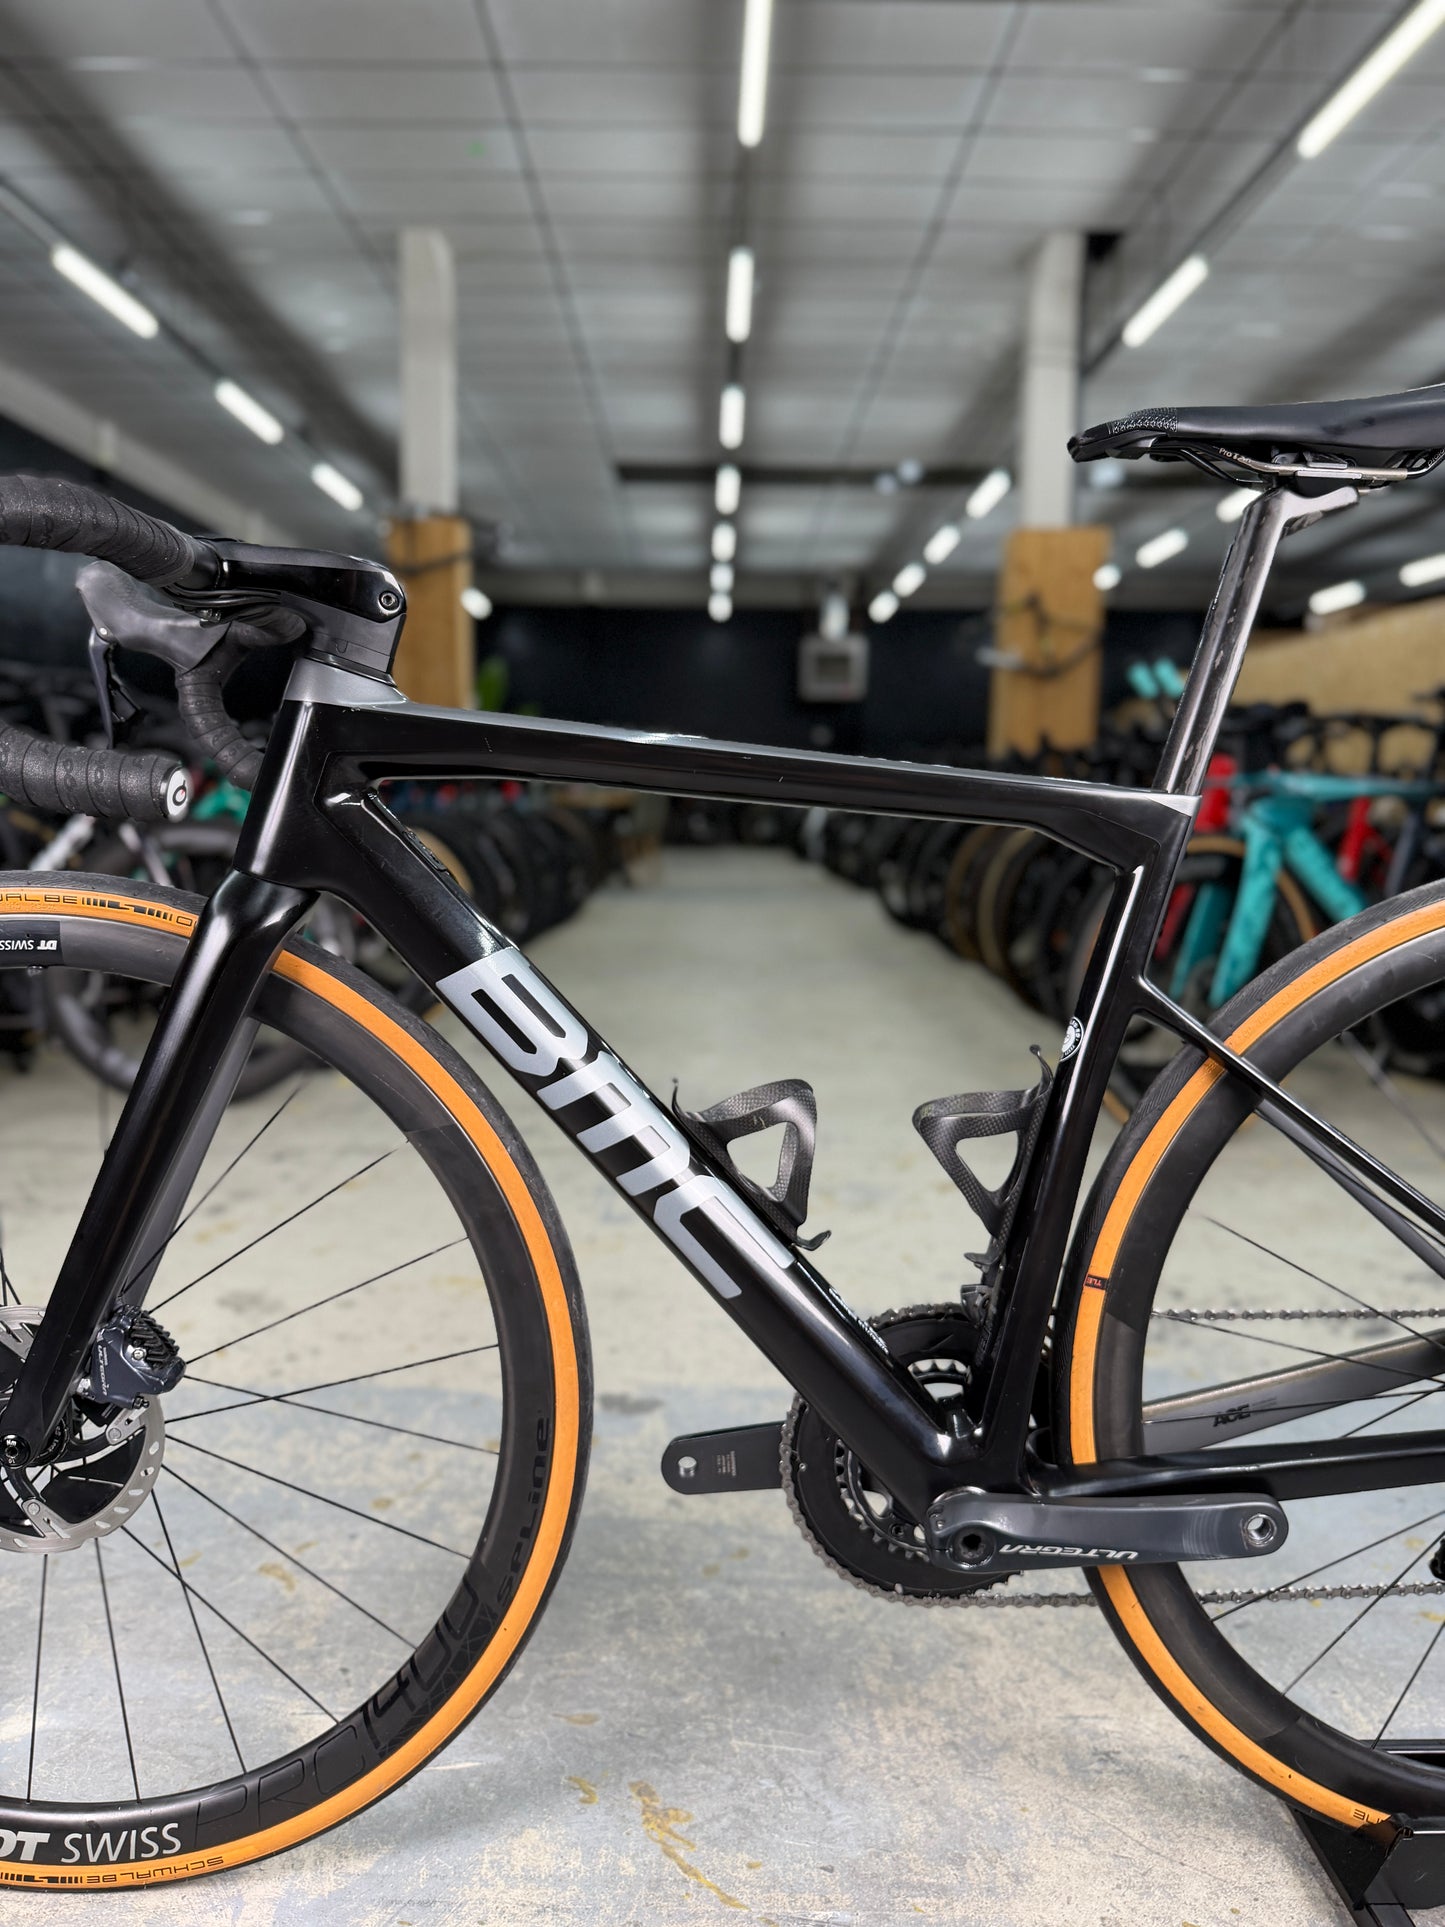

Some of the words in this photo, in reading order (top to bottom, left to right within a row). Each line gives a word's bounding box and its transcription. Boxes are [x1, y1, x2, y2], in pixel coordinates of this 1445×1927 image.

[0, 893, 78, 904] ALBE
[37, 940, 58, 951] DT
[436, 946, 796, 1300] BMC
[999, 1544, 1139, 1560] ULTEGRA
[61, 1822, 182, 1864] SWISS
[86, 1856, 224, 1884] SCHWALBE
